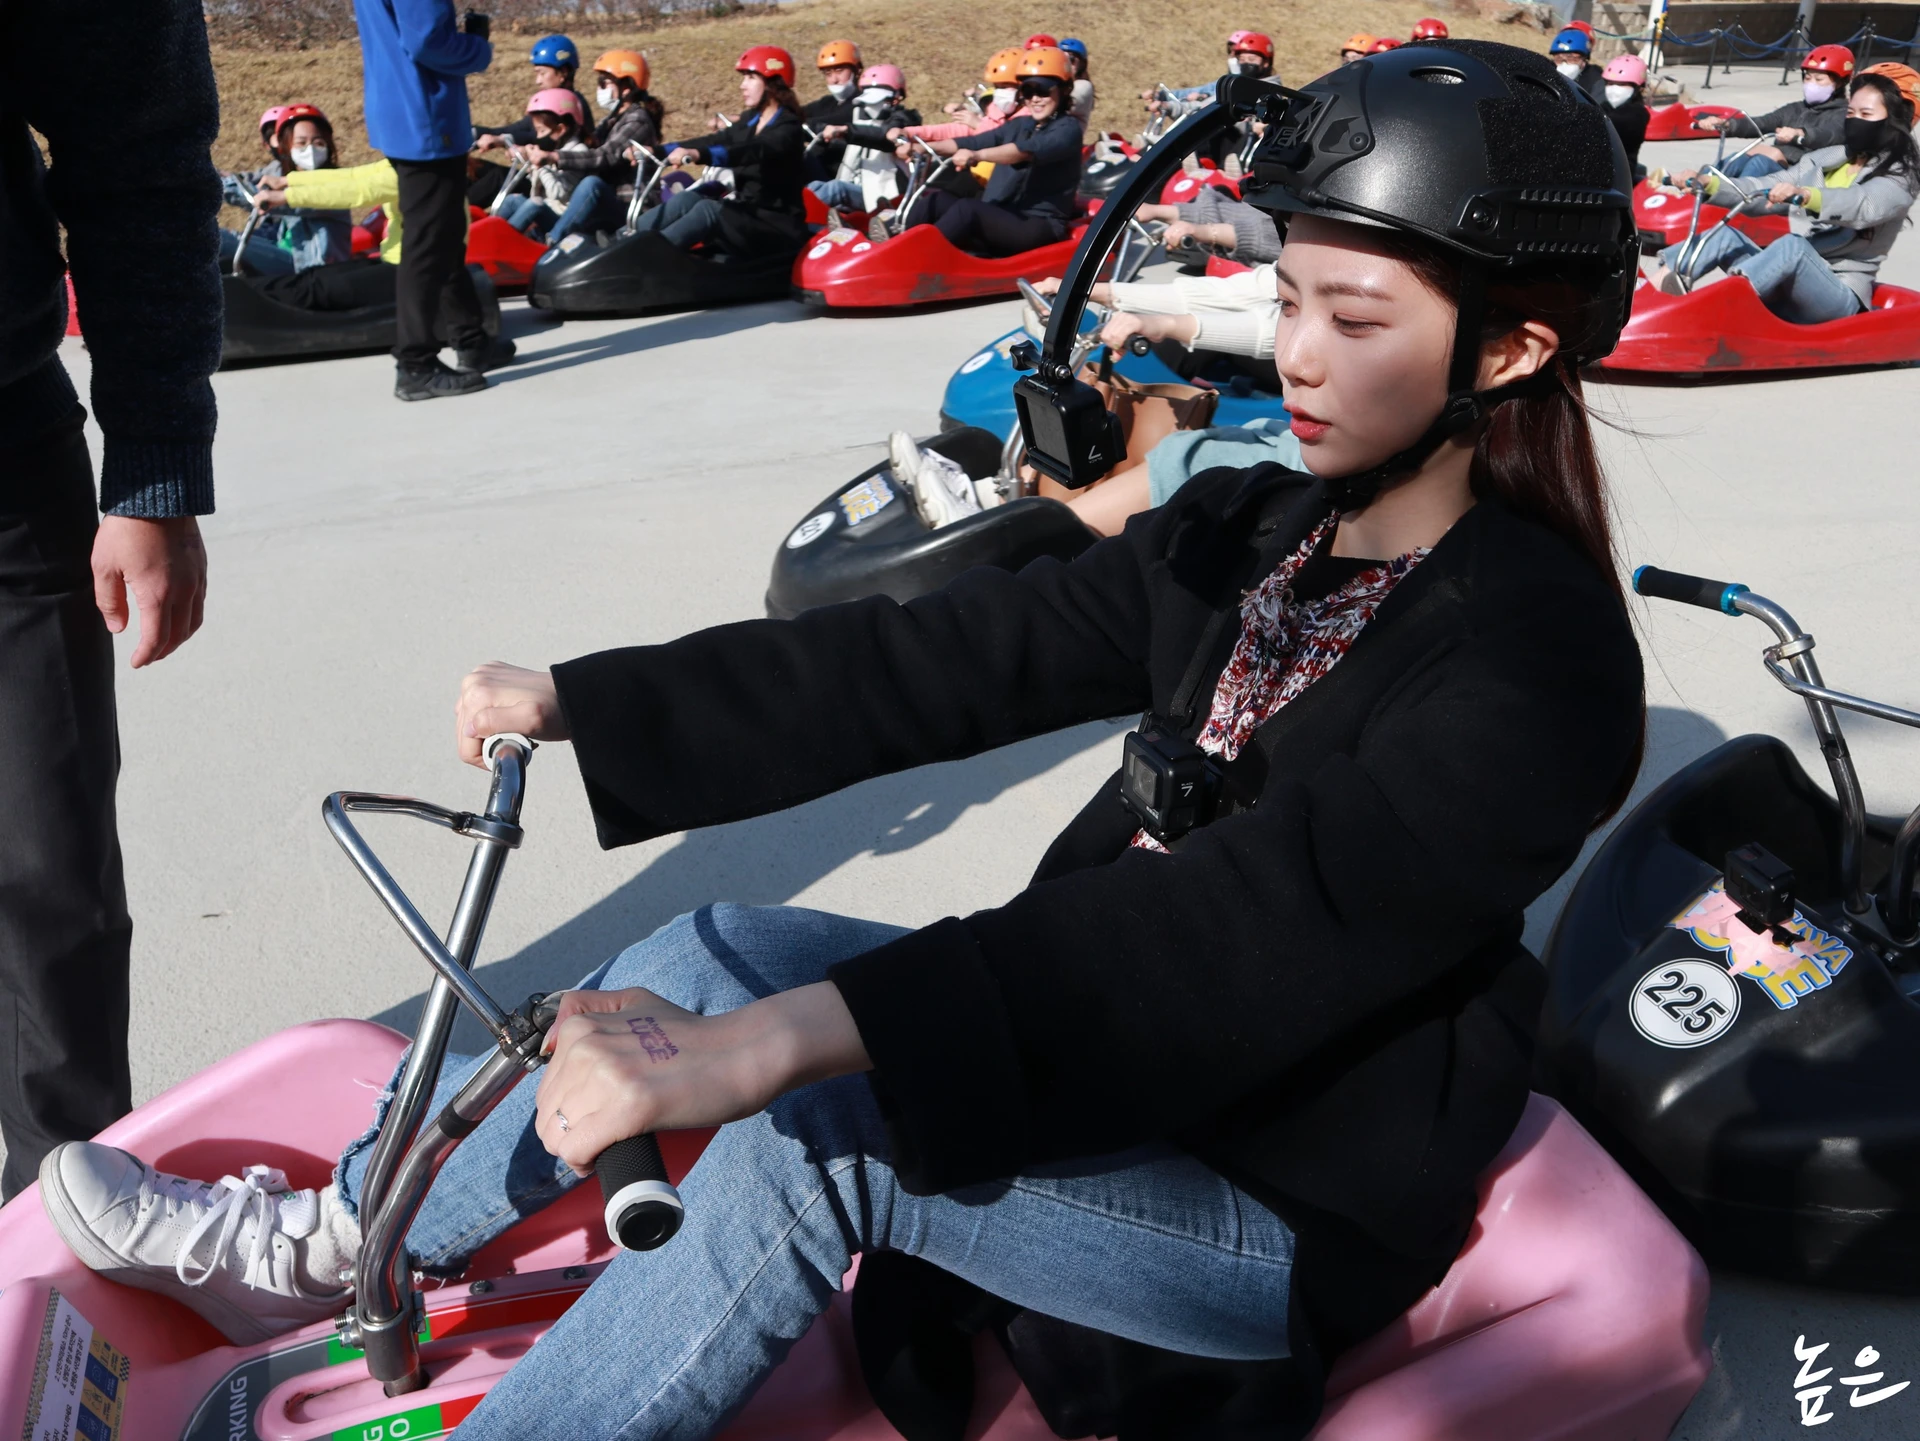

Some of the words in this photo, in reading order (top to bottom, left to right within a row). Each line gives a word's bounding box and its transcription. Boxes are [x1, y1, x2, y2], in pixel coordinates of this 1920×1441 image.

[1181, 785, 1193, 797] 7
[1642, 969, 1729, 1034] 225
[626, 1017, 670, 1064] LUGE
[29, 1339, 53, 1424] INFORMATION
[363, 1418, 410, 1441] GO
